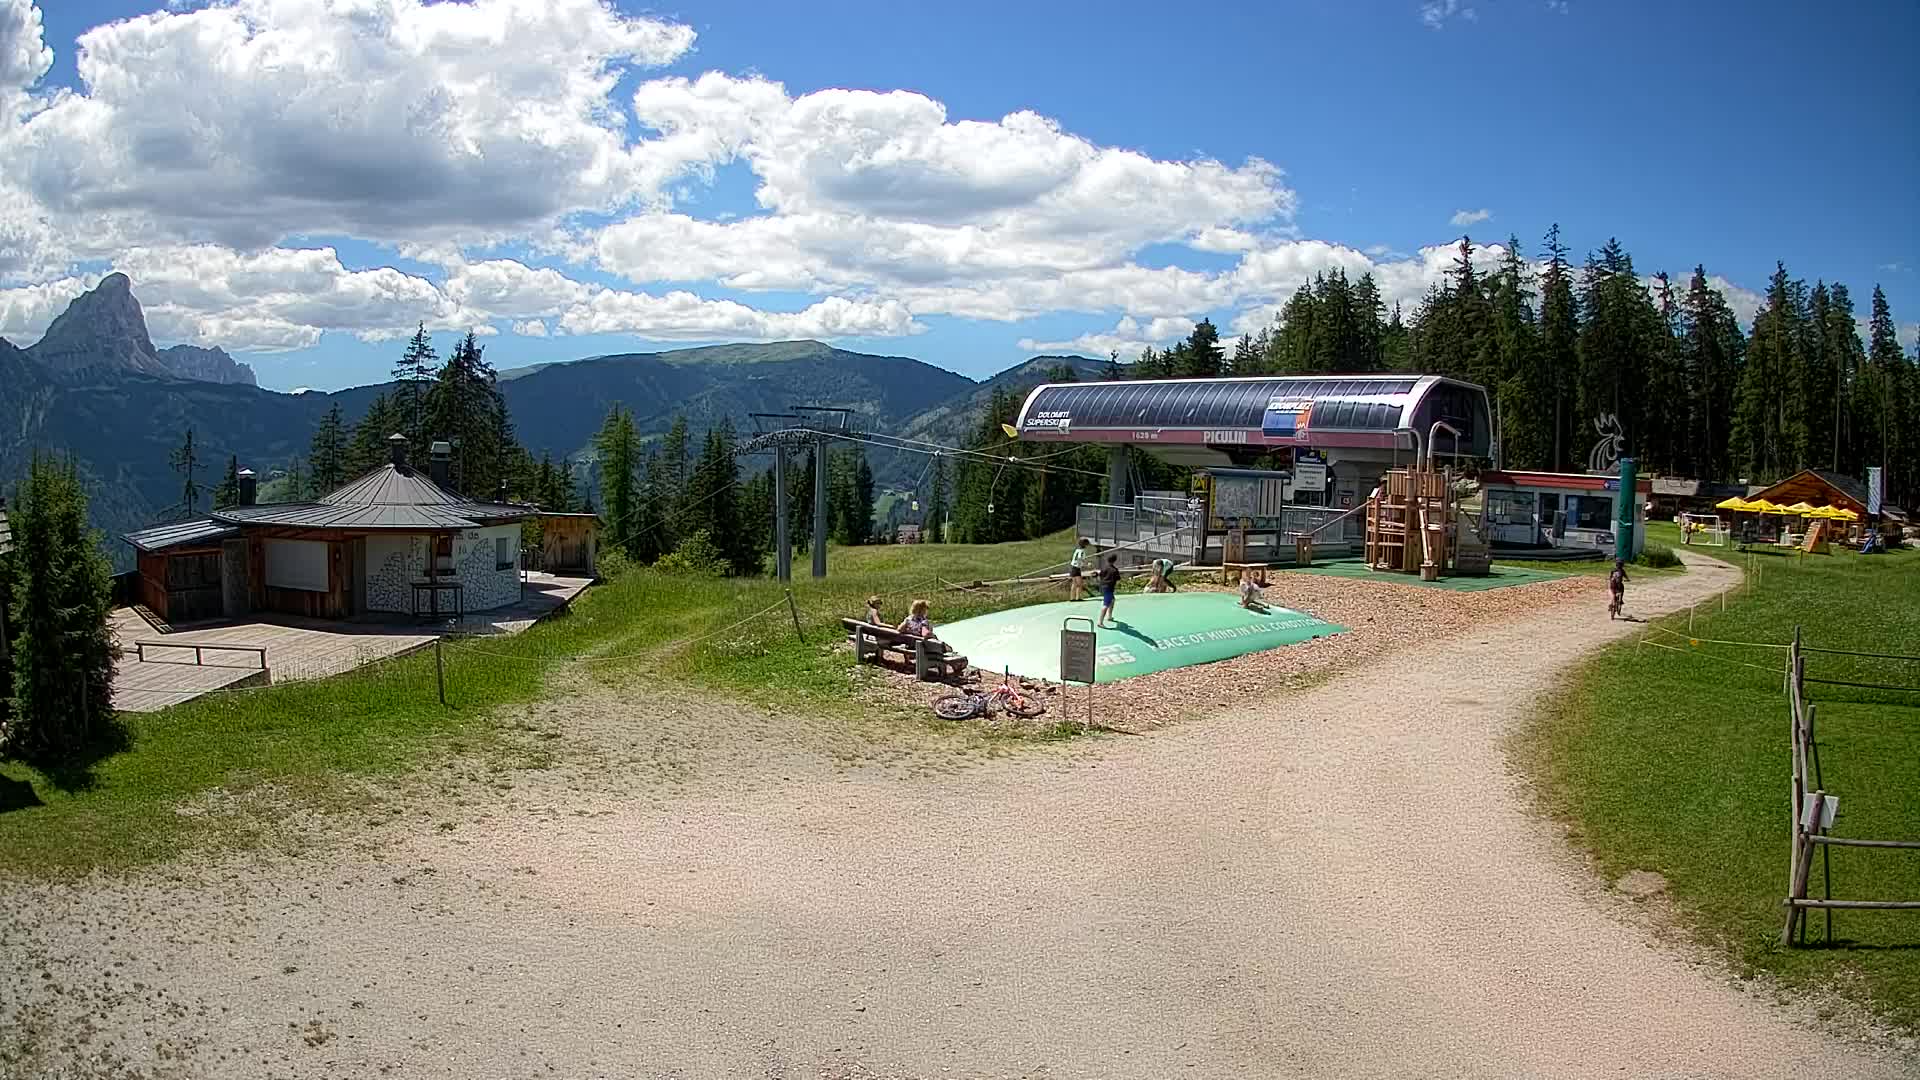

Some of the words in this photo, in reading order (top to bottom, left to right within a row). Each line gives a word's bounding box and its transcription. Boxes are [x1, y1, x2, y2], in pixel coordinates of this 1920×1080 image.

[1203, 431, 1247, 443] PICULIN
[1190, 633, 1206, 643] OF
[1207, 629, 1237, 641] MIND
[1236, 627, 1250, 637] IN
[1250, 624, 1271, 634] ALL
